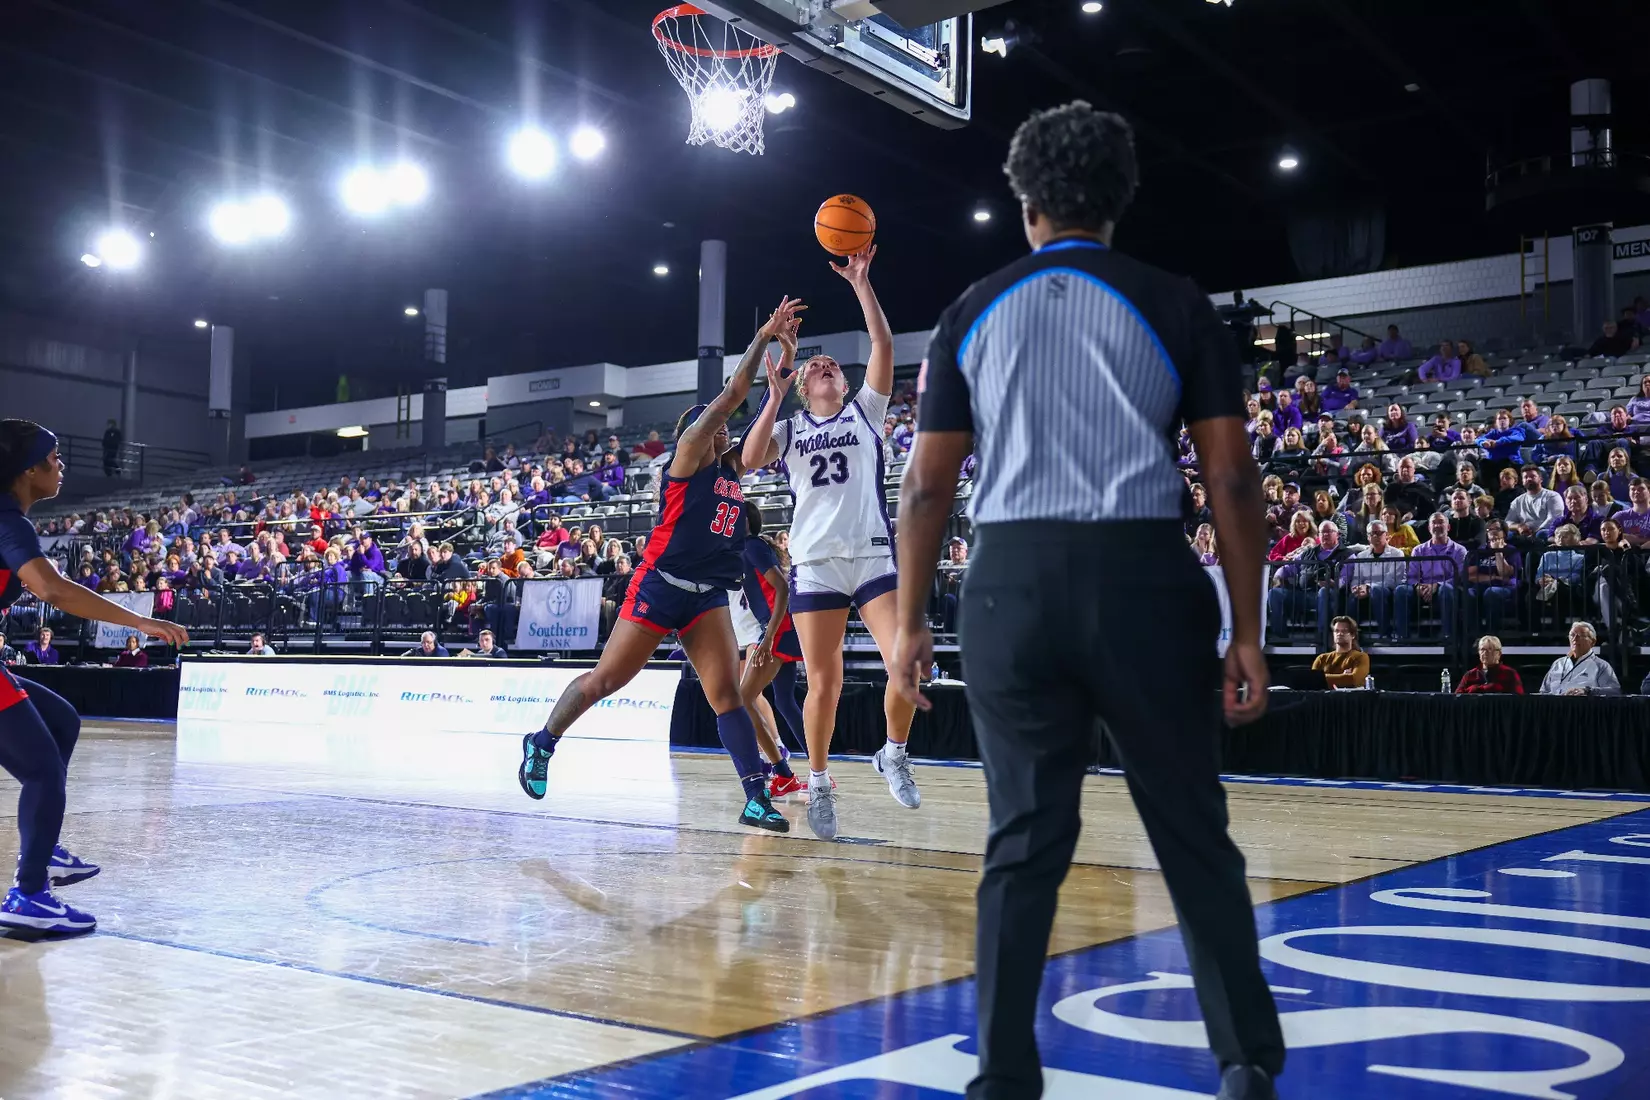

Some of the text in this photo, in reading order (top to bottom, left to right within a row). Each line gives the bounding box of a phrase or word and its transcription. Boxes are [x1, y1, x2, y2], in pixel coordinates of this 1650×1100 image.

[1615, 241, 1650, 257] MEN
[795, 430, 860, 457] Wildcats
[810, 451, 849, 487] 23
[710, 501, 740, 537] 32
[528, 622, 588, 637] Southern
[542, 639, 571, 648] BANK
